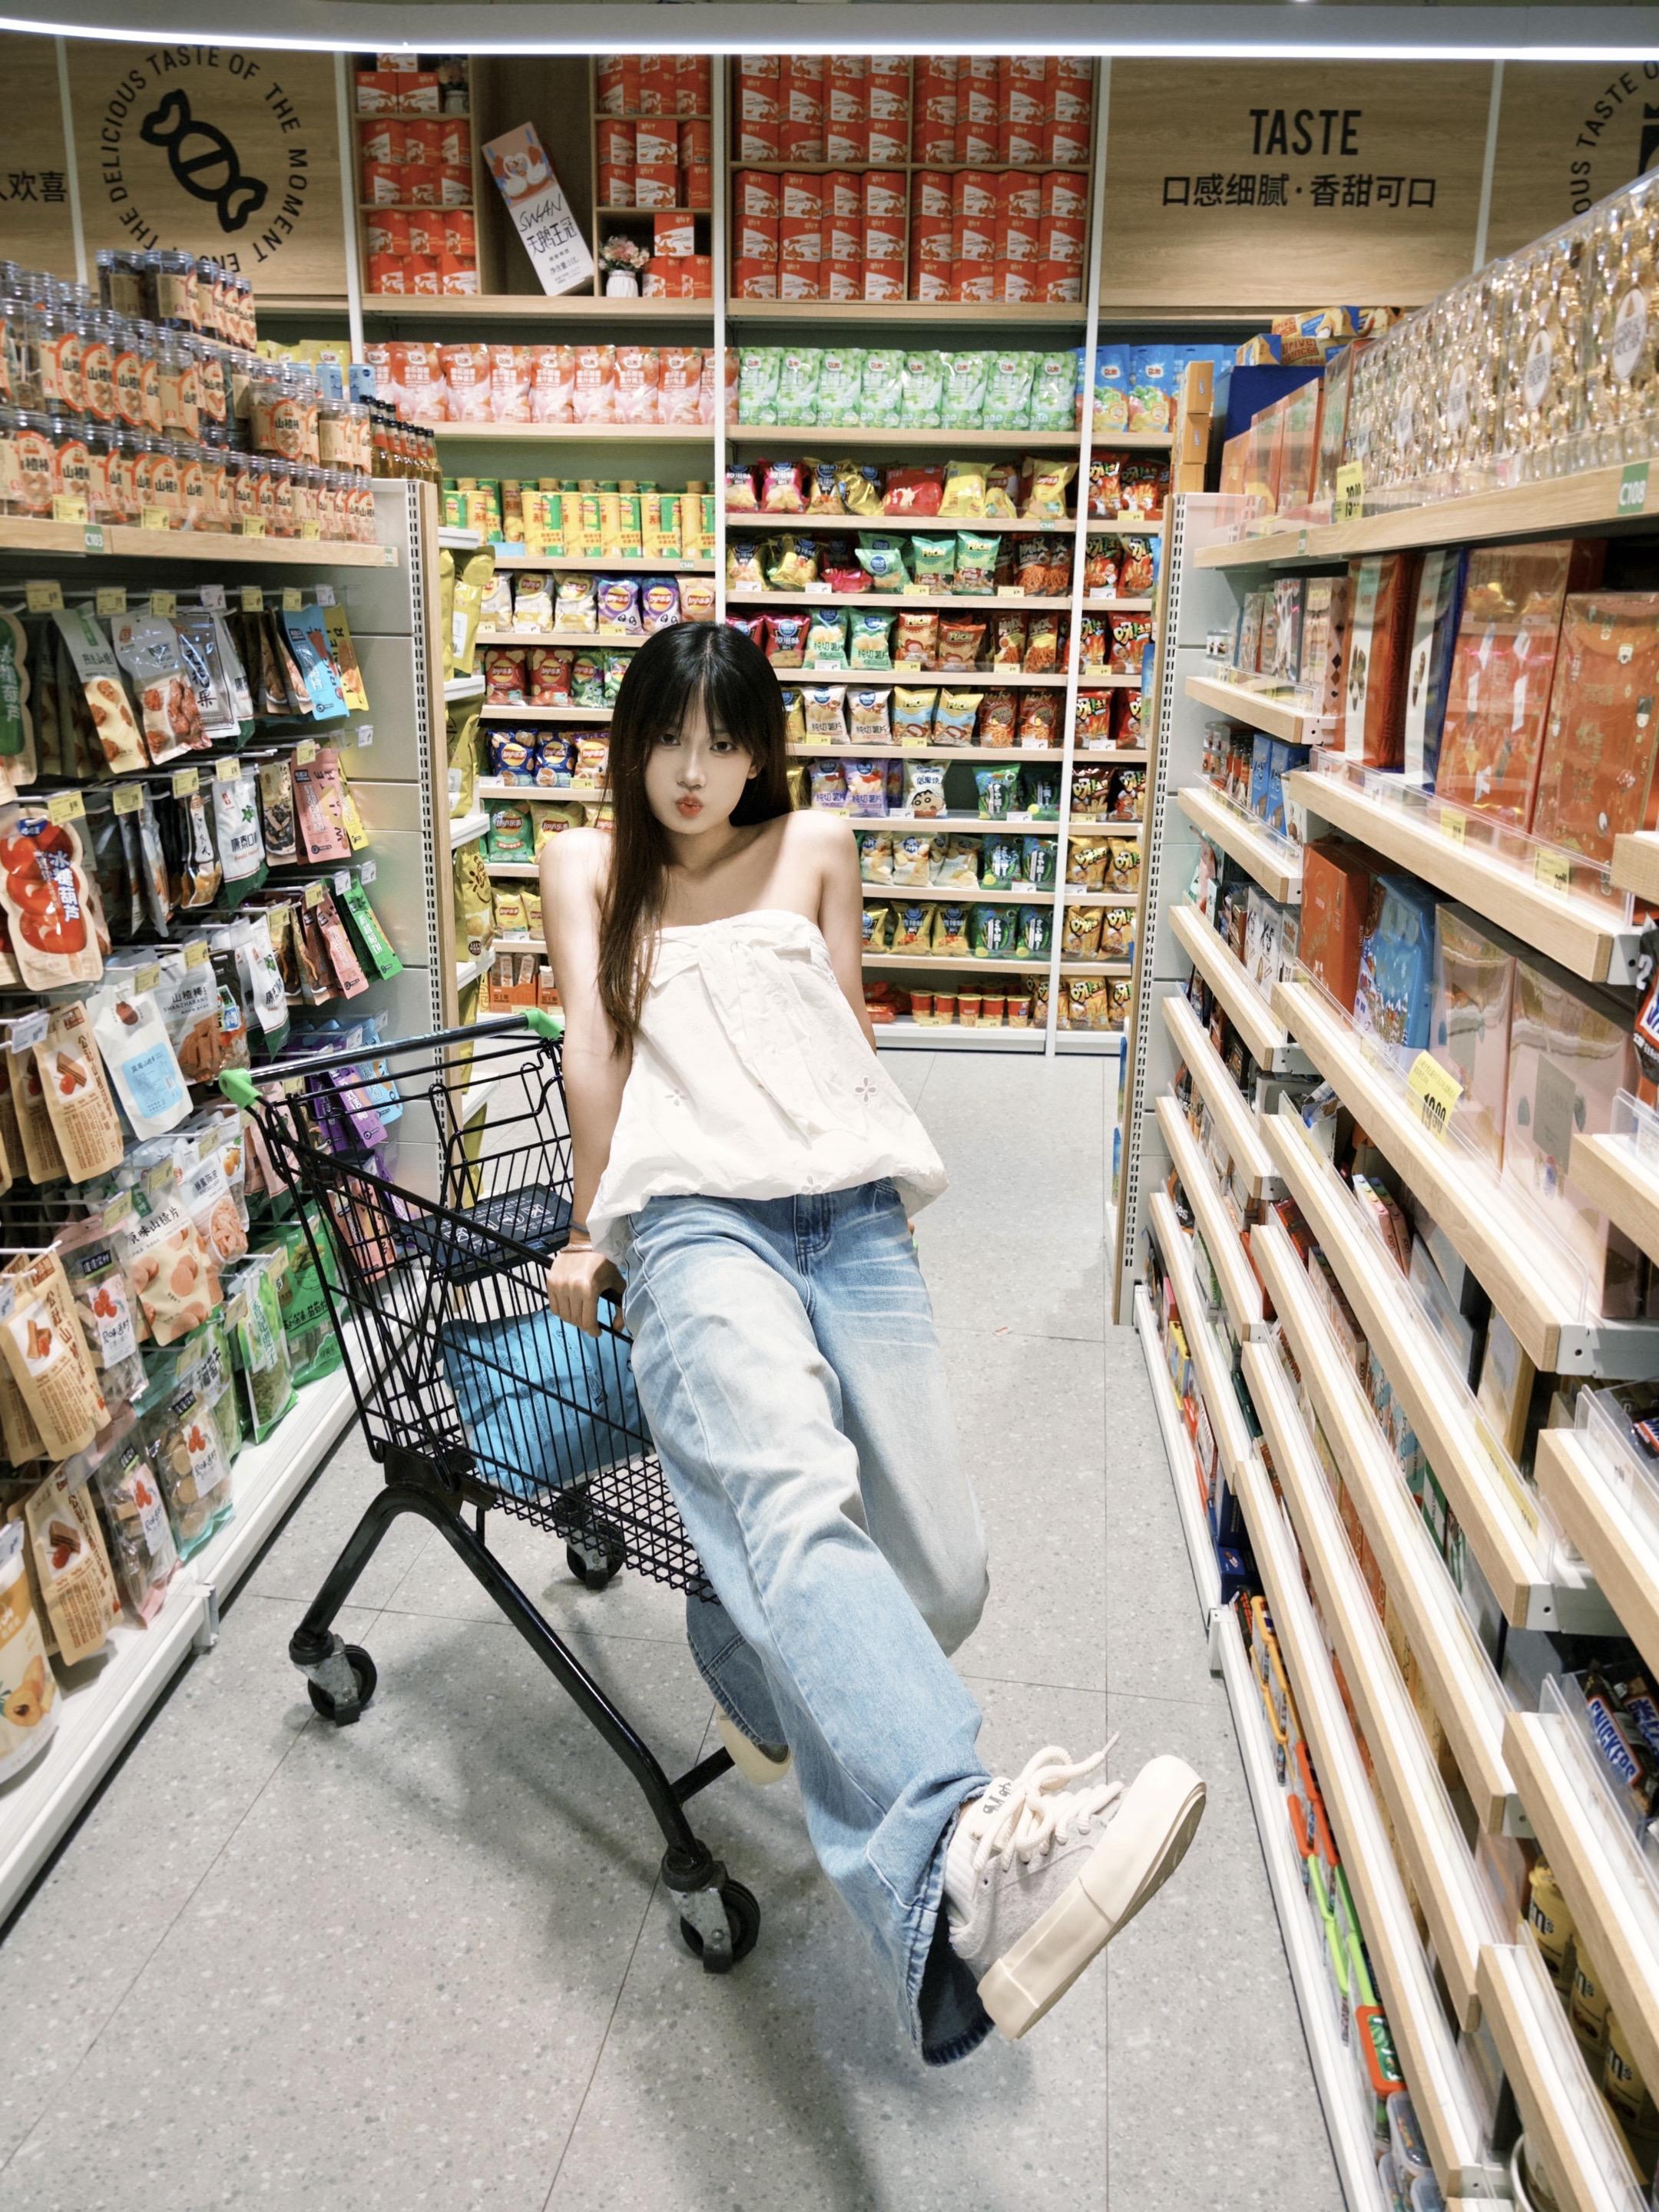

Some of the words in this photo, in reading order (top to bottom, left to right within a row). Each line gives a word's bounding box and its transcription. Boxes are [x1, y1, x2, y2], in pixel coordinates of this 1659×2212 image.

[151, 45, 220, 76] TASTE
[229, 53, 260, 81] OF
[264, 82, 301, 134] THE
[1576, 72, 1638, 147] TASTE
[103, 69, 147, 203] DELICIOUS
[1250, 109, 1362, 155] TASTE
[253, 147, 307, 262] MOMENT
[1162, 173, 1437, 209] 口感细腻·香甜可口
[119, 207, 158, 250] THE
[519, 194, 562, 233] SWAN
[527, 216, 578, 257] 天鹅王冠
[1589, 1697, 1637, 1785] SNICKERS
